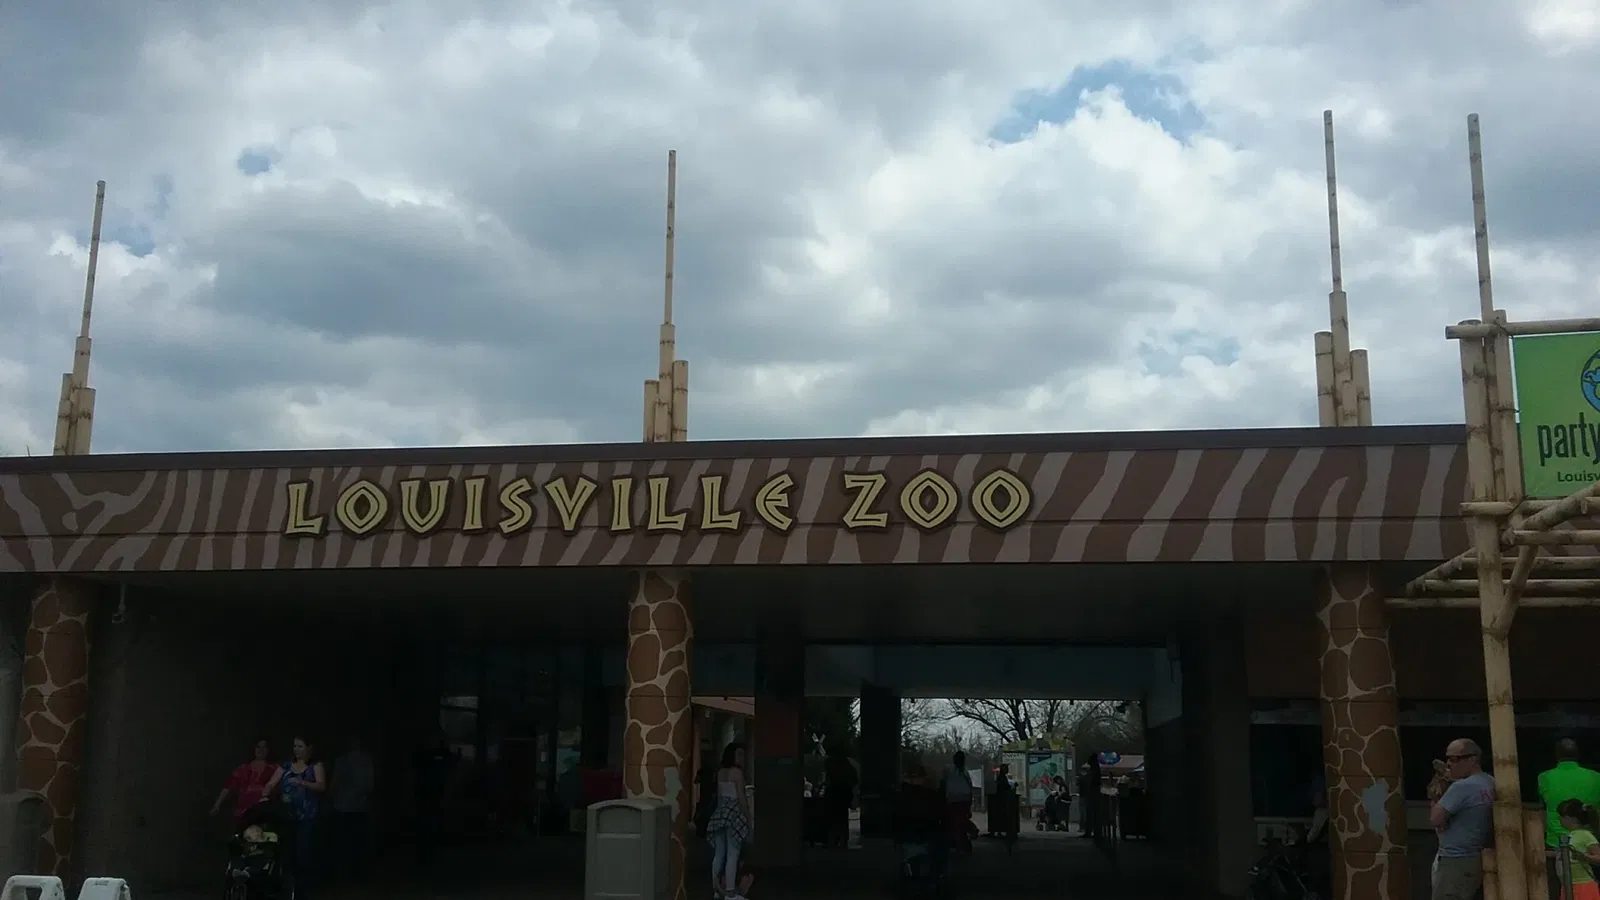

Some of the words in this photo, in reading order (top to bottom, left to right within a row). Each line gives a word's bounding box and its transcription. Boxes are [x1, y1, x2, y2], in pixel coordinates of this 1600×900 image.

[1537, 411, 1600, 467] party
[284, 472, 796, 535] LOUISVILLE
[841, 469, 1032, 530] ZOO
